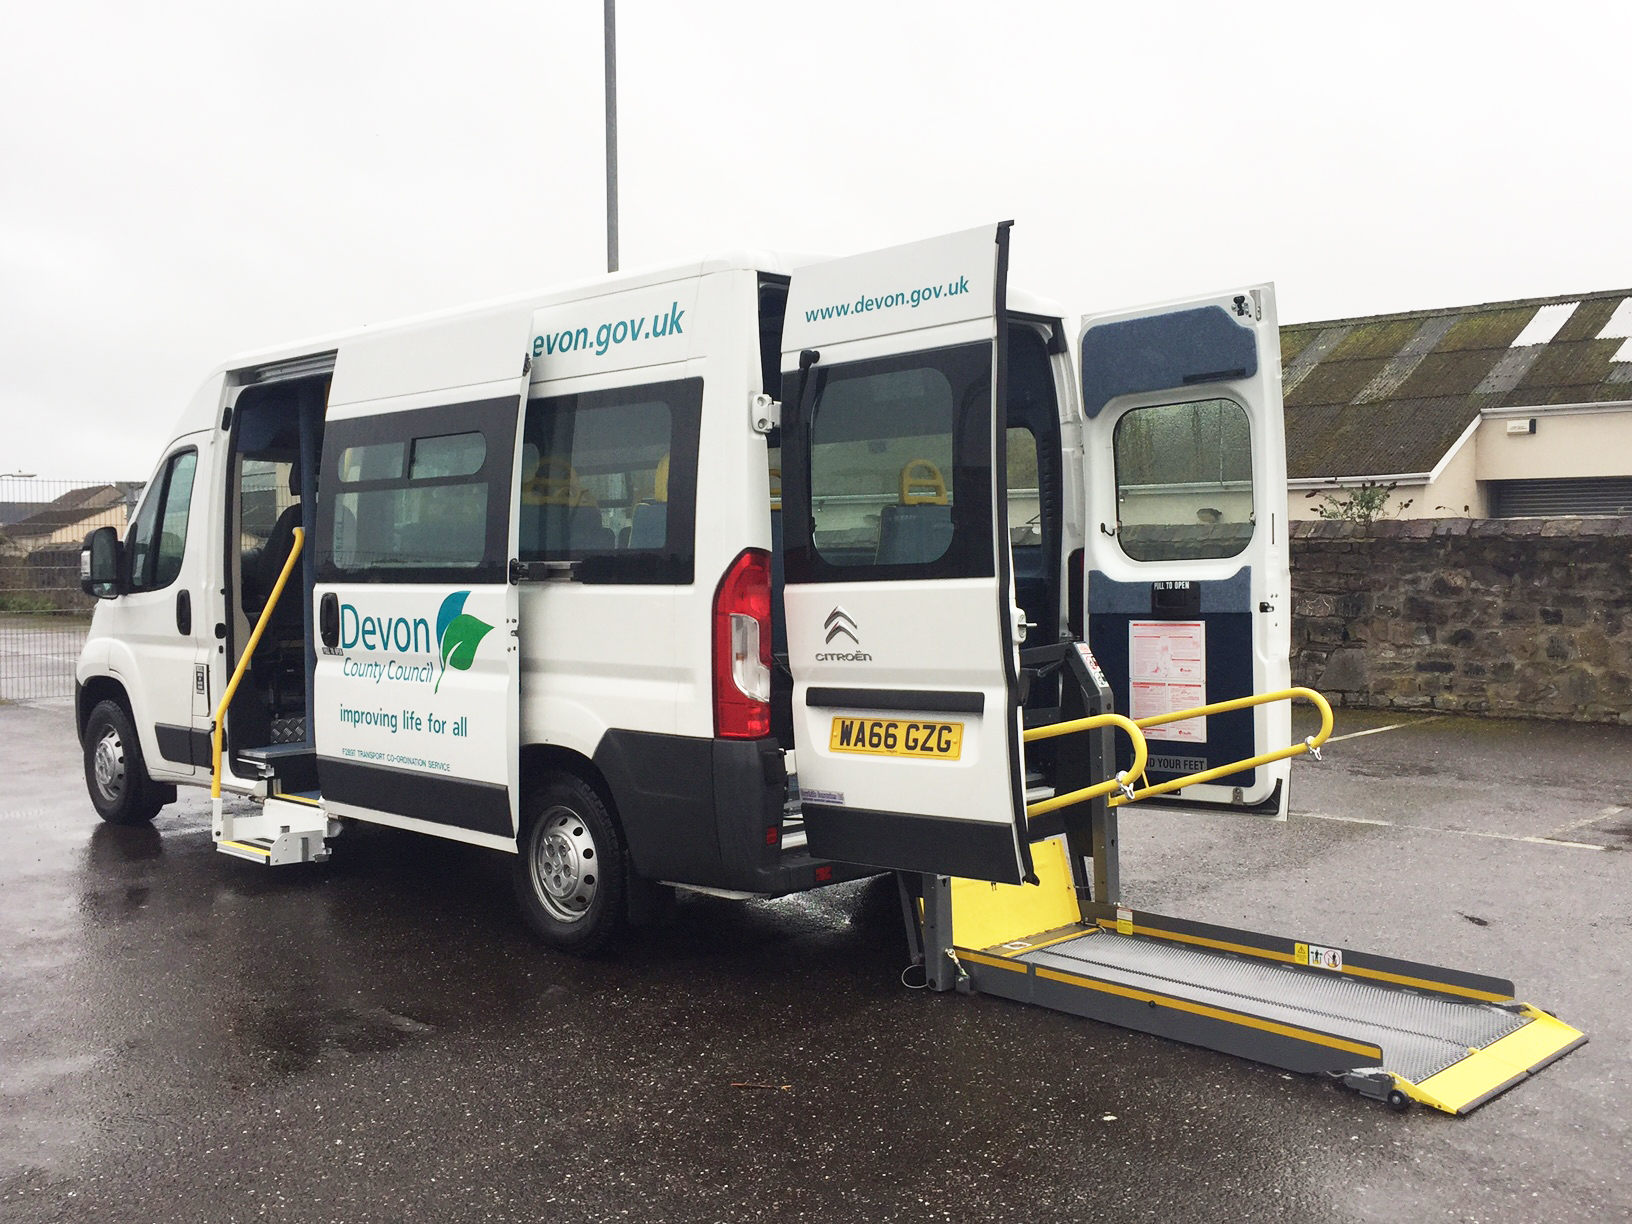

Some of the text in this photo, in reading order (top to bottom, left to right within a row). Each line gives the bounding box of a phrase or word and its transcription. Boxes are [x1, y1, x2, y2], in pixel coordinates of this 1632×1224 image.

[805, 275, 970, 323] www.devon.gov.uk
[532, 301, 686, 357] evon.gov.uk
[1153, 581, 1190, 591] PULL TO OPEN
[340, 603, 431, 653] Devon
[343, 657, 434, 684] County Council
[815, 650, 873, 662] CITROËN
[340, 703, 468, 738] improving life for all
[839, 720, 953, 753] WA66 GZG
[357, 749, 385, 761] TRANSPORT
[386, 753, 427, 768] CO-ORDINATION
[427, 759, 451, 772] SERVICE
[1157, 758, 1182, 769] YOUR
[1183, 759, 1204, 770] FEET
